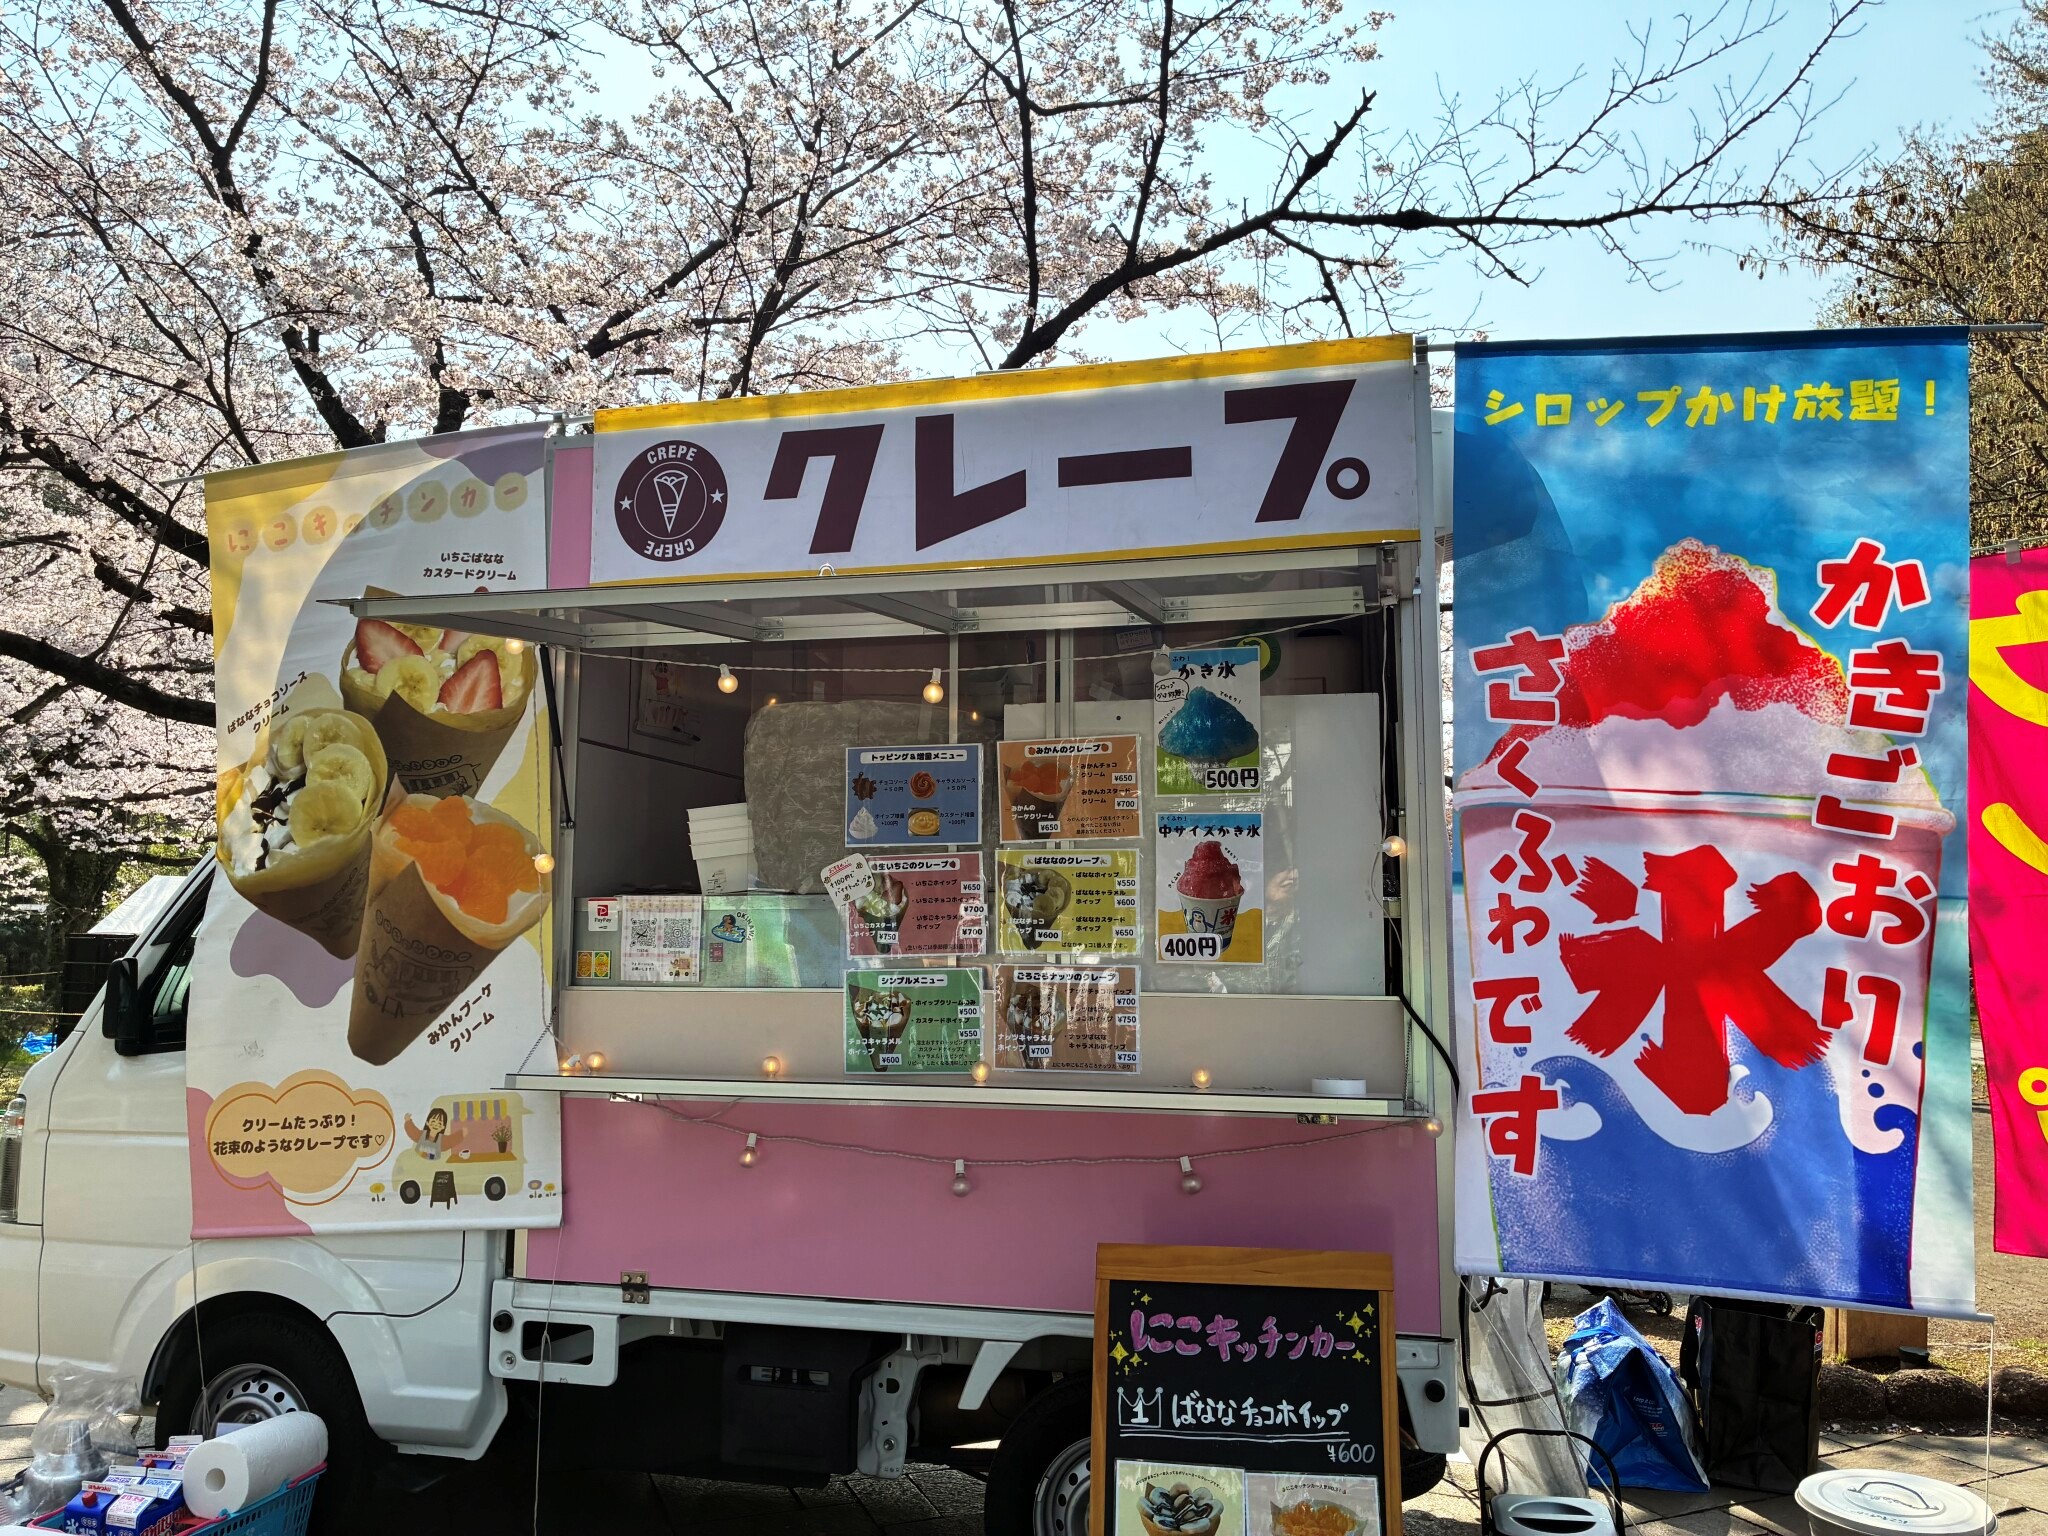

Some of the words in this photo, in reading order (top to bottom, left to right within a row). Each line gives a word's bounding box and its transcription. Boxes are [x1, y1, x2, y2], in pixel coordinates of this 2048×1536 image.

[1483, 378, 1935, 428] シロップかけ放題！
[647, 444, 698, 465] CREPE
[764, 379, 1370, 554] クレープ
[227, 485, 519, 553] にこキッチンカー
[643, 537, 696, 558] CREPE
[441, 552, 504, 565] いちごばなな
[423, 567, 517, 582] カスタードクリーム
[1178, 660, 1236, 679] かき氷
[227, 670, 308, 736] ばななチョコソース
[252, 704, 290, 734] クリーム
[1036, 744, 1101, 754] みかんのクレープ
[1114, 774, 1133, 782] ¥650
[1206, 767, 1259, 788] 500円
[1811, 539, 1942, 1067] かきごおり
[1040, 823, 1059, 831] ¥650
[1158, 824, 1261, 838] 中サイズかき氷
[878, 860, 950, 871] 生いちごのクレープ
[1034, 856, 1100, 865] ばななのクレープ
[962, 883, 981, 891] ¥650
[1116, 879, 1136, 887] ¥550
[1116, 898, 1136, 906] ¥600
[1471, 628, 1577, 1178] さくふわです
[736, 912, 755, 941] OKINAWA
[962, 928, 983, 936] ¥700
[878, 933, 896, 941] ¥750
[1037, 931, 1059, 939] ¥600
[1164, 936, 1217, 957] 400円
[881, 976, 945, 985] シンプルメニュー
[1017, 972, 1117, 981] ごろごろナッツのクレープ
[1559, 844, 1833, 1115] 氷
[1116, 998, 1136, 1006] ¥700
[427, 983, 493, 1045] みかんブーケ
[450, 1011, 495, 1052] クリーム
[998, 1034, 1055, 1042] ナッツキャラメル
[1031, 1047, 1050, 1055] ¥700
[1117, 1054, 1136, 1062] ¥750
[881, 1056, 900, 1064] ¥600
[242, 1114, 357, 1133] クリームたっぷり！
[1130, 1309, 1355, 1362] にこキッチンカー
[1172, 1390, 1349, 1429] ばななチョコホイップ
[1327, 1443, 1375, 1464] ¥600
